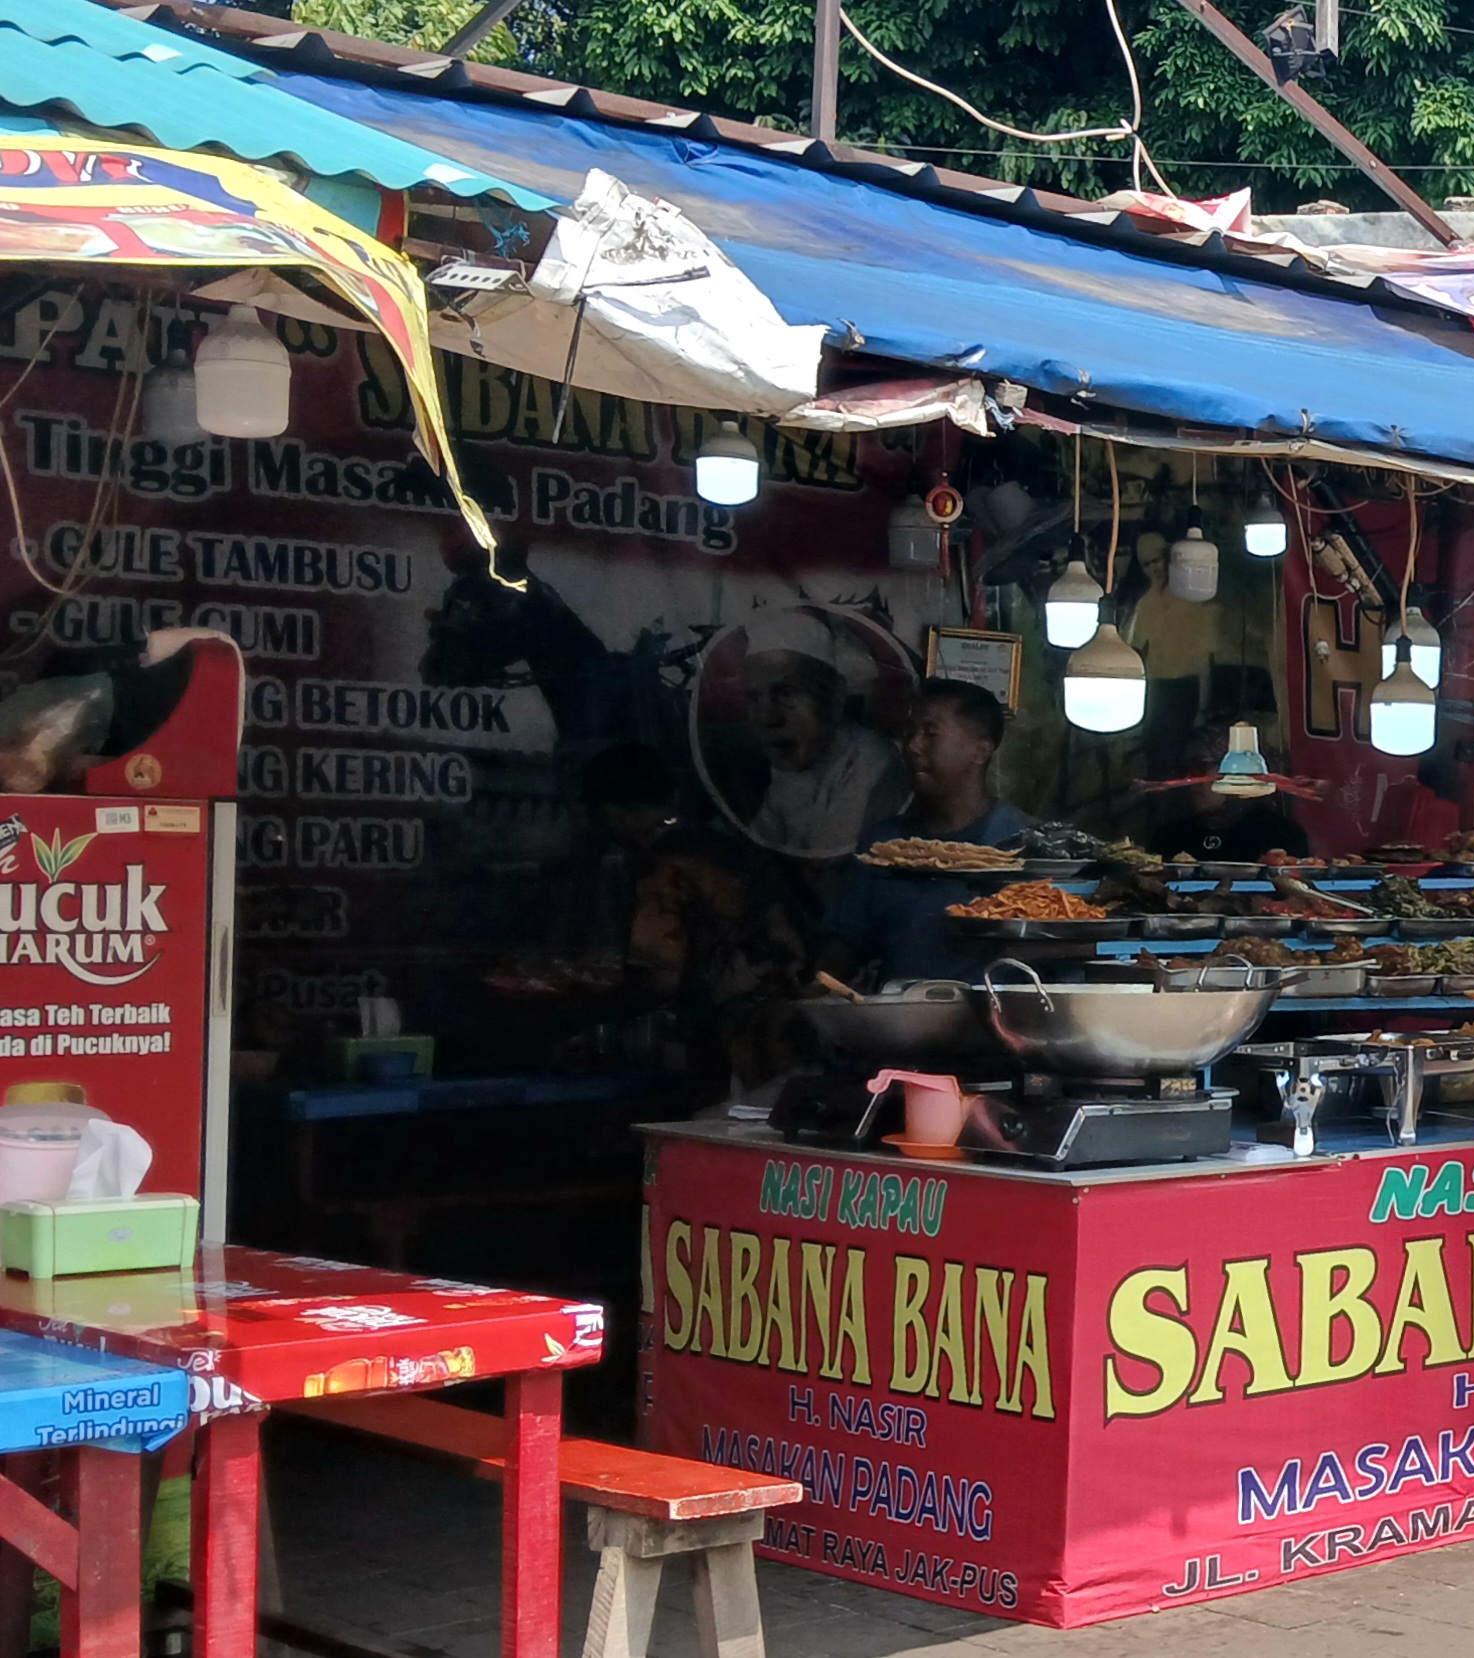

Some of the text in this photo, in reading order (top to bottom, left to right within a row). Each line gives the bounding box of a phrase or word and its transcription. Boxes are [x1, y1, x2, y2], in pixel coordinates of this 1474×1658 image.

[17, 410, 231, 498] Tinggi
[532, 466, 738, 555] Padang
[46, 521, 413, 595] GULE TAMBUSU
[296, 679, 513, 735] BETOKOK
[298, 751, 472, 802] KERING
[298, 816, 425, 869] PARU
[30, 1034, 52, 1056] di
[56, 1032, 172, 1056] Pucuknya!
[45, 1006, 85, 1026] Teh
[88, 1004, 171, 1025] Terbaik
[760, 1159, 948, 1238] NASI KAPAU
[664, 1218, 1056, 1420] SABANA BANA
[63, 1382, 161, 1415] Mineral
[788, 1385, 928, 1449] H. NASIR
[850, 1454, 994, 1542] PADANG
[821, 1526, 891, 1578] RAYA
[895, 1548, 1019, 1609] JAK-PUS
[1162, 1555, 1260, 1598] JL.
